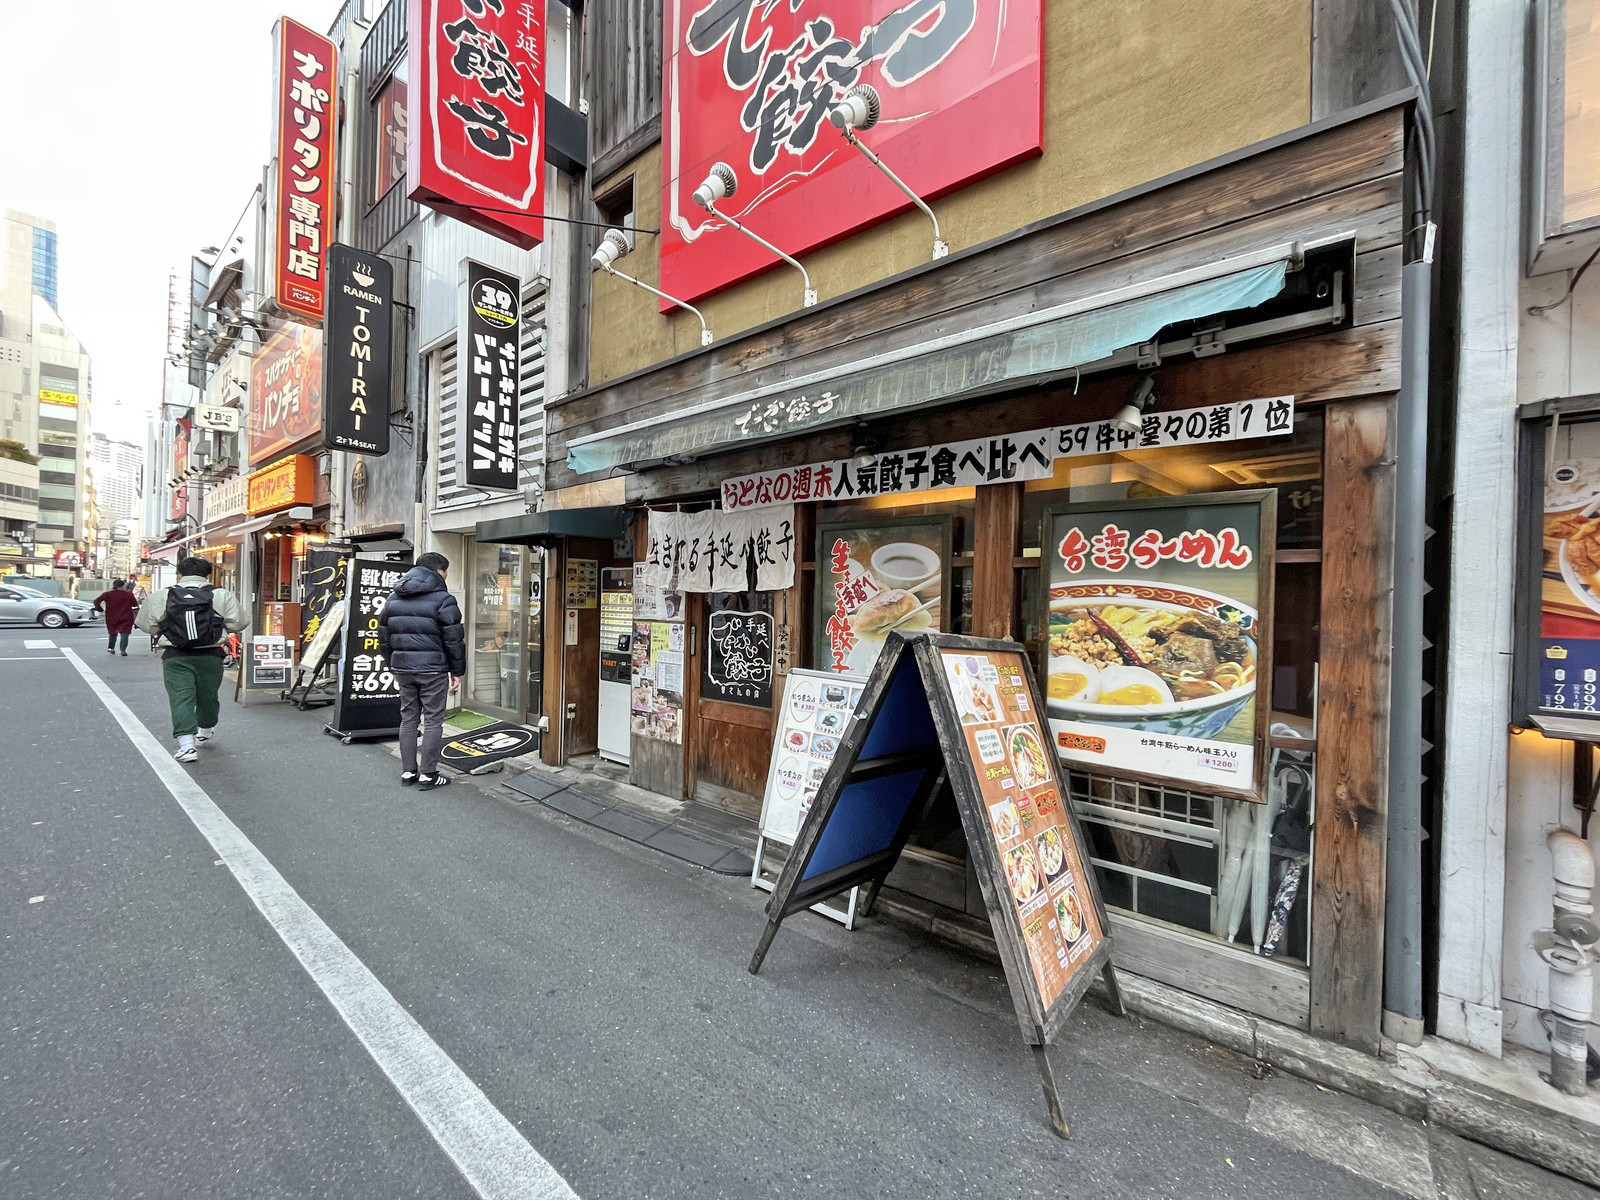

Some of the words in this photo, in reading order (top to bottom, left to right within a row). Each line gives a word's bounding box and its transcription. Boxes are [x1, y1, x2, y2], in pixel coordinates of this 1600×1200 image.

[287, 48, 330, 281] ナポリタン専門店
[343, 285, 383, 305] RAMEN
[481, 284, 512, 311] 39
[350, 305, 372, 431] TOMIRAI
[498, 341, 516, 474] サンキューミガキ
[335, 435, 348, 445] 2F
[348, 437, 377, 450] 14SEAT
[1060, 526, 1250, 571] 台湾らーめん
[360, 568, 406, 588] 靴修
[746, 618, 769, 649] 手延べ
[1205, 758, 1233, 769] ¥1200
